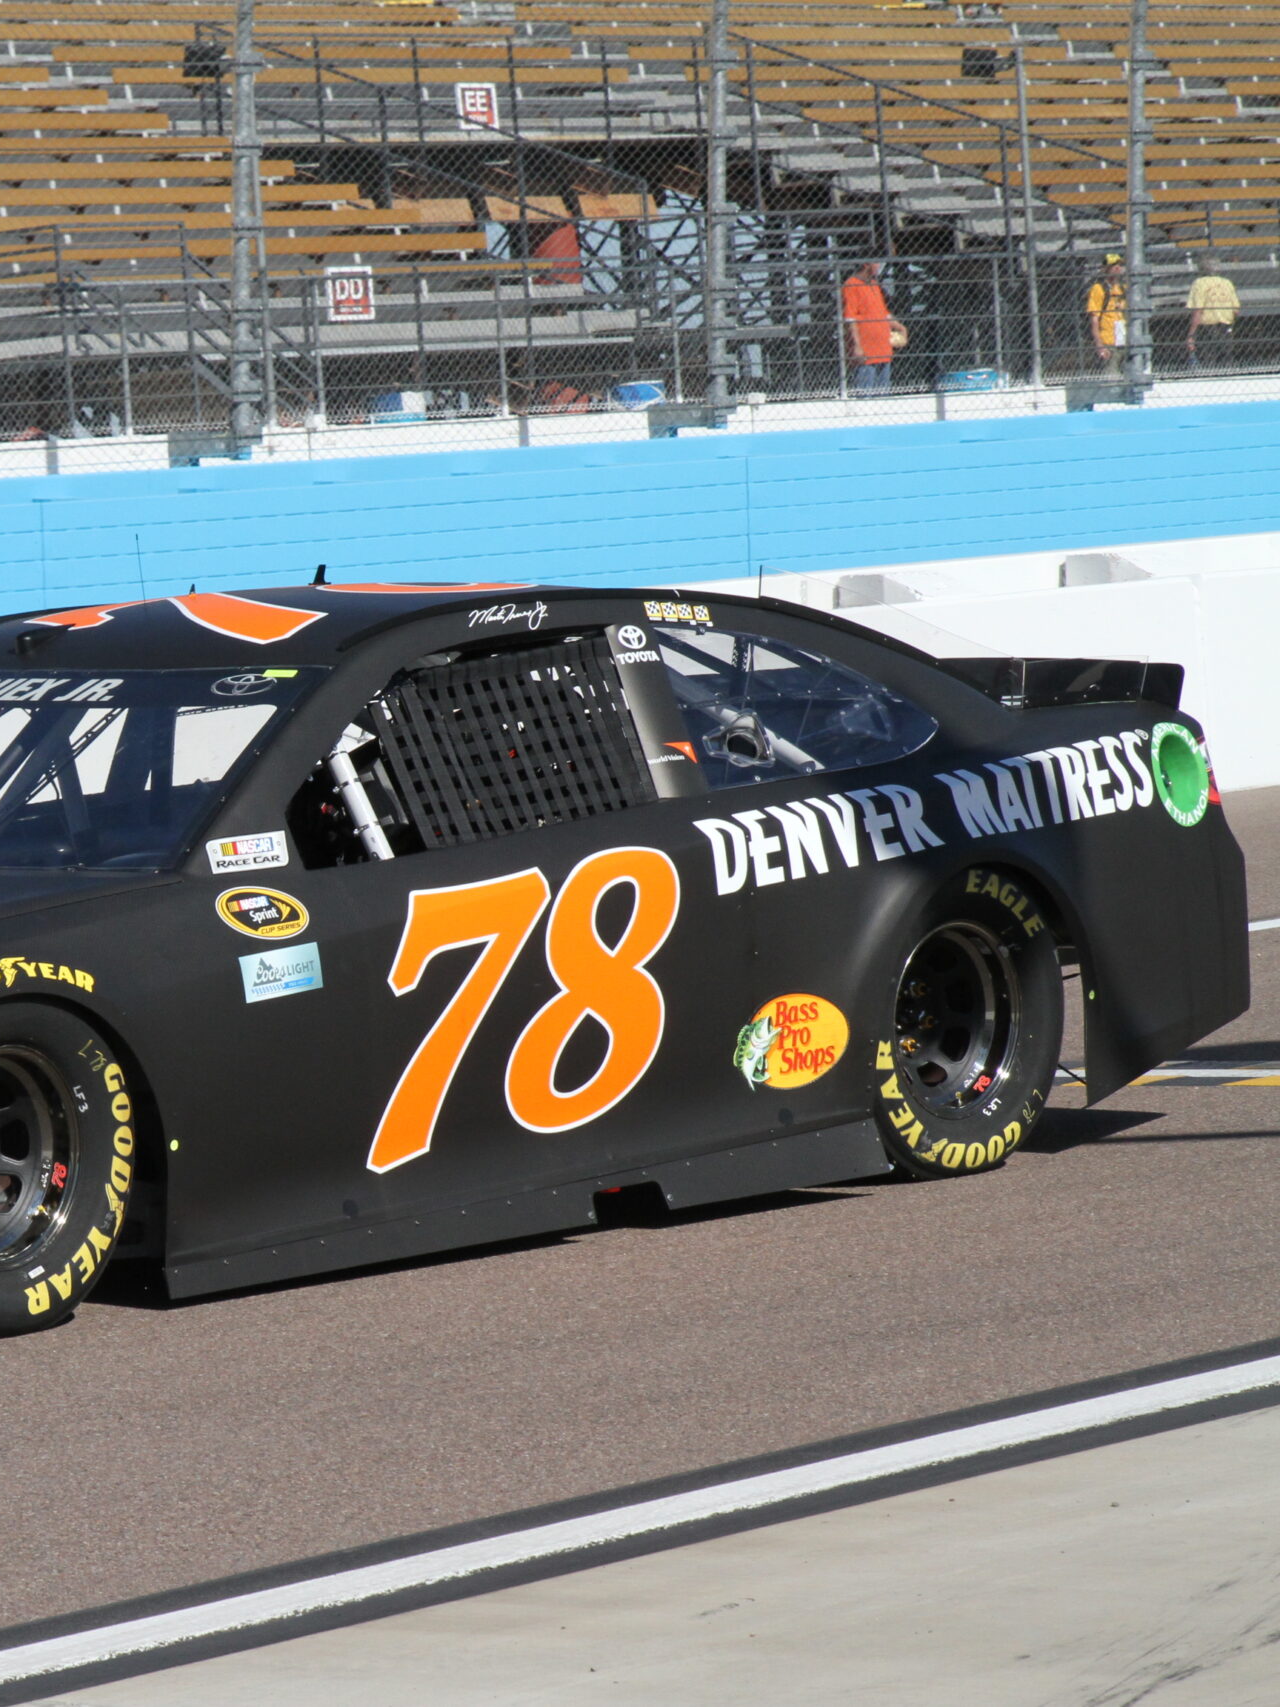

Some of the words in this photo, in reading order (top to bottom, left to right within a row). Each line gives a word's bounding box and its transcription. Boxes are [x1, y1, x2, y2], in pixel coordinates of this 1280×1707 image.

[464, 90, 489, 112] EE
[334, 278, 363, 300] DD
[616, 650, 660, 665] TOYOTA
[52, 678, 124, 702] JR.
[1151, 723, 1199, 762] AMERICAN
[692, 784, 946, 896] DENVER
[933, 731, 1154, 839] MATTRESS
[1164, 788, 1209, 826] ETHANOL
[236, 837, 273, 855] NASCAR
[216, 858, 251, 869] RACE
[253, 855, 281, 865] CAR
[240, 896, 269, 911] NASCAR
[966, 869, 1044, 937] EAGLE
[249, 907, 279, 924] Sprint
[261, 926, 276, 935] CUP
[277, 922, 301, 932] SERIES
[286, 960, 315, 977] LIGHT
[366, 846, 680, 1174] 78
[775, 1001, 819, 1027] Bass
[777, 1025, 811, 1050] Pro
[780, 1045, 836, 1075] Shops
[876, 1040, 1022, 1169] GOODYEAR
[24, 1063, 133, 1316] GOODYEAR
